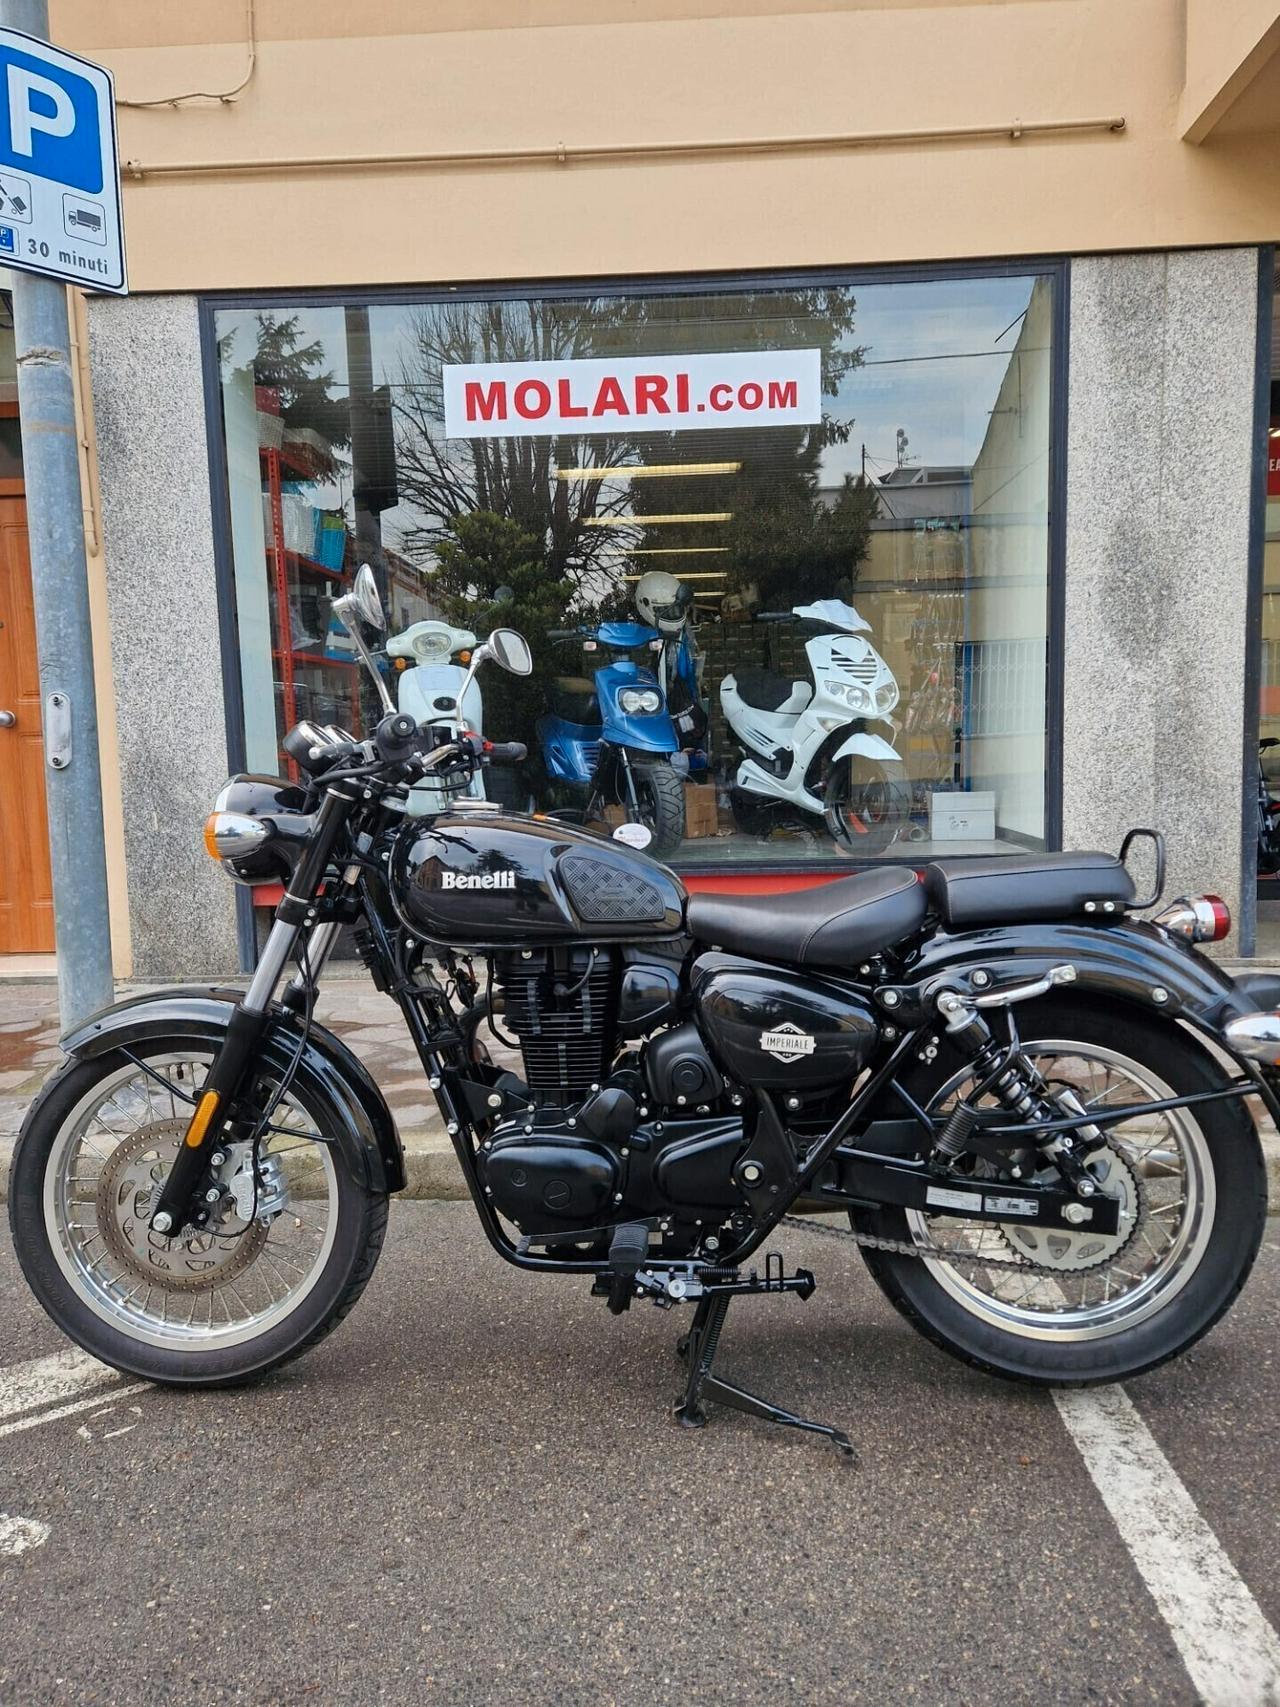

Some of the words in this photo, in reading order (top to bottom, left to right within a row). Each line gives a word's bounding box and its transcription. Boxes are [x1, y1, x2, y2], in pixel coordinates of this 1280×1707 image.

[7, 63, 76, 158] P
[28, 238, 50, 258] 30
[58, 250, 109, 275] minuti
[441, 871, 516, 890] Benelli
[766, 1036, 809, 1050] IMPERIALE
